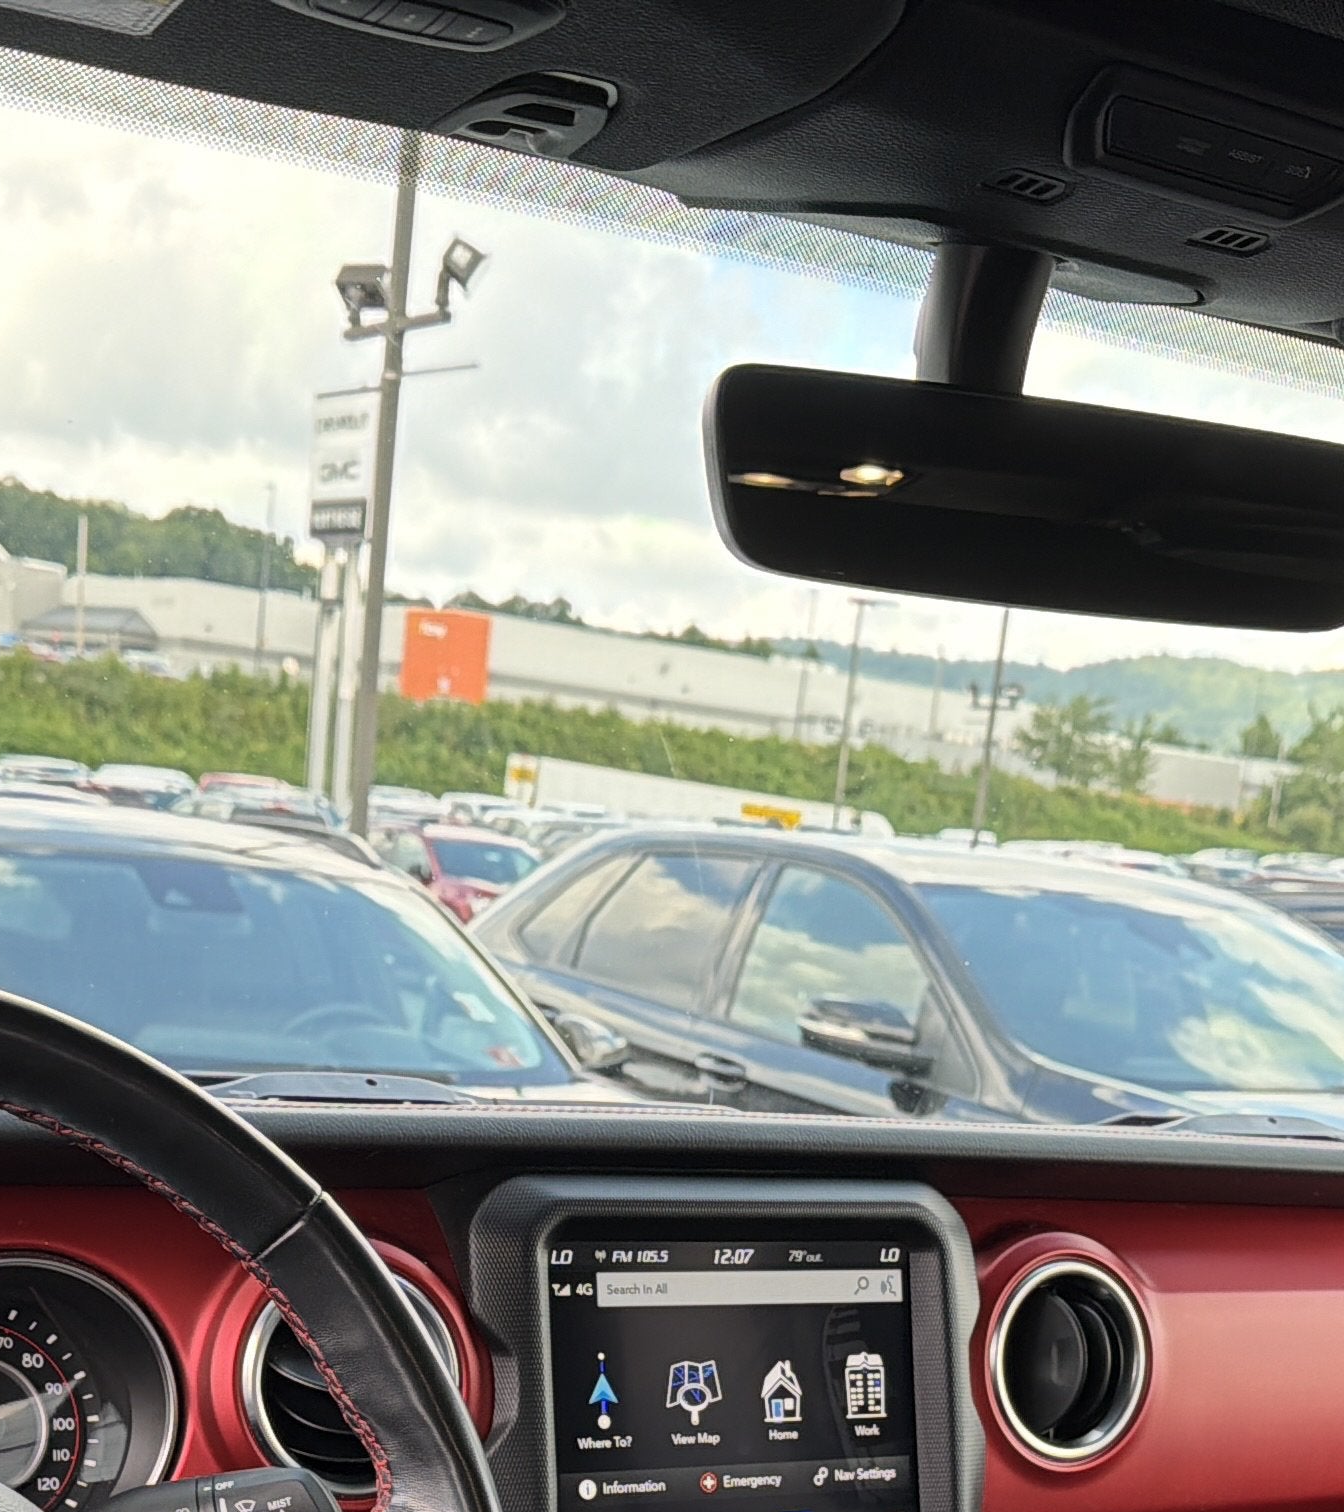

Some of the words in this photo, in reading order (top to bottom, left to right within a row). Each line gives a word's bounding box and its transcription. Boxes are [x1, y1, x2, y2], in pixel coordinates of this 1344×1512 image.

[551, 1249, 573, 1265] LO
[611, 1251, 633, 1264] FM
[636, 1250, 669, 1264] 105.5
[713, 1249, 755, 1265] 12:07
[879, 1248, 900, 1263] LO
[575, 1283, 593, 1296] 4G
[606, 1283, 640, 1297] Search
[642, 1283, 653, 1295] In
[654, 1282, 668, 1295] All
[22, 1353, 44, 1369] 80
[44, 1382, 63, 1395] 90
[52, 1417, 75, 1431] 100
[768, 1428, 799, 1441] Home
[855, 1425, 880, 1438] Work
[577, 1436, 611, 1450] Where
[614, 1435, 633, 1449] To?
[671, 1433, 694, 1446] View
[697, 1432, 721, 1448] Map
[52, 1448, 71, 1462] 110
[834, 1469, 854, 1481] Nav
[856, 1466, 897, 1482] Settings
[37, 1477, 60, 1491] 120
[215, 1481, 234, 1491] OFF
[602, 1479, 666, 1495] Information
[723, 1473, 782, 1491] Emergency
[267, 1497, 292, 1511] MIST
